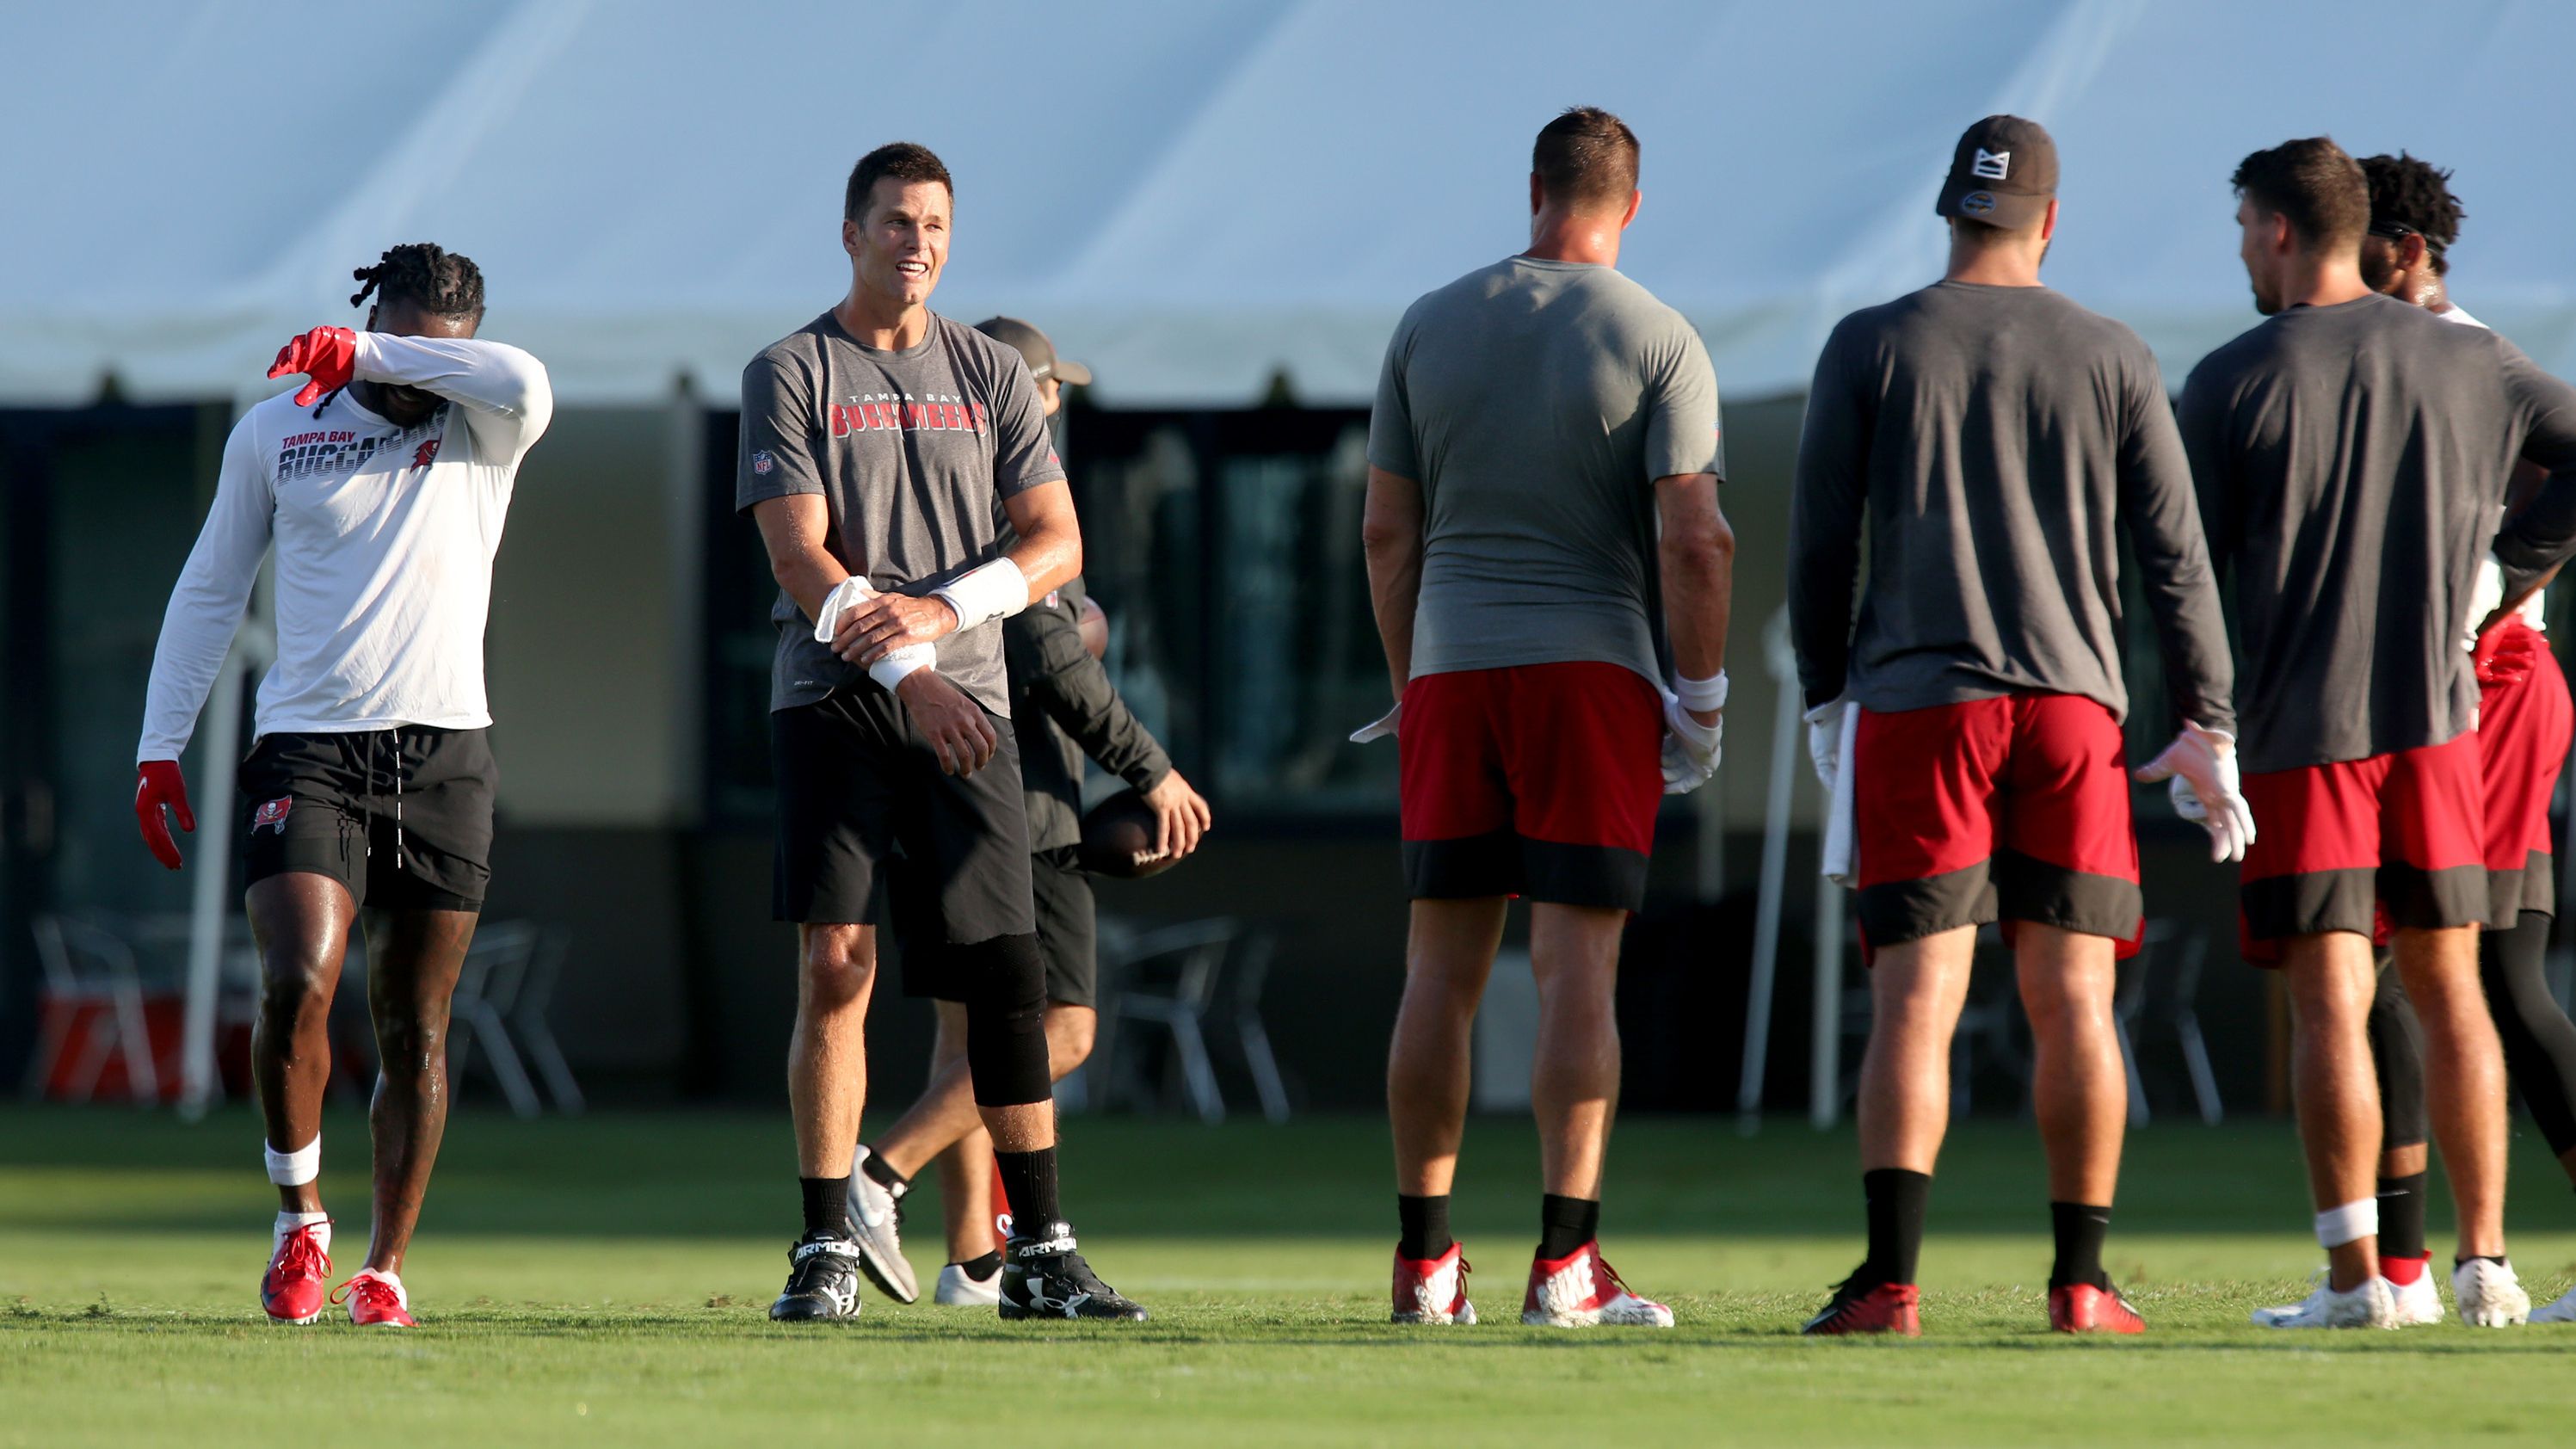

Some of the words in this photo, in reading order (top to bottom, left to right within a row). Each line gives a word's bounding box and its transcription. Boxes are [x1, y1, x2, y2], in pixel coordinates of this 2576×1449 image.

[849, 392, 915, 403] TAMPA
[926, 393, 962, 404] BAY
[282, 431, 325, 448] TAMPA
[328, 431, 356, 443] BAY
[756, 459, 772, 472] NFL
